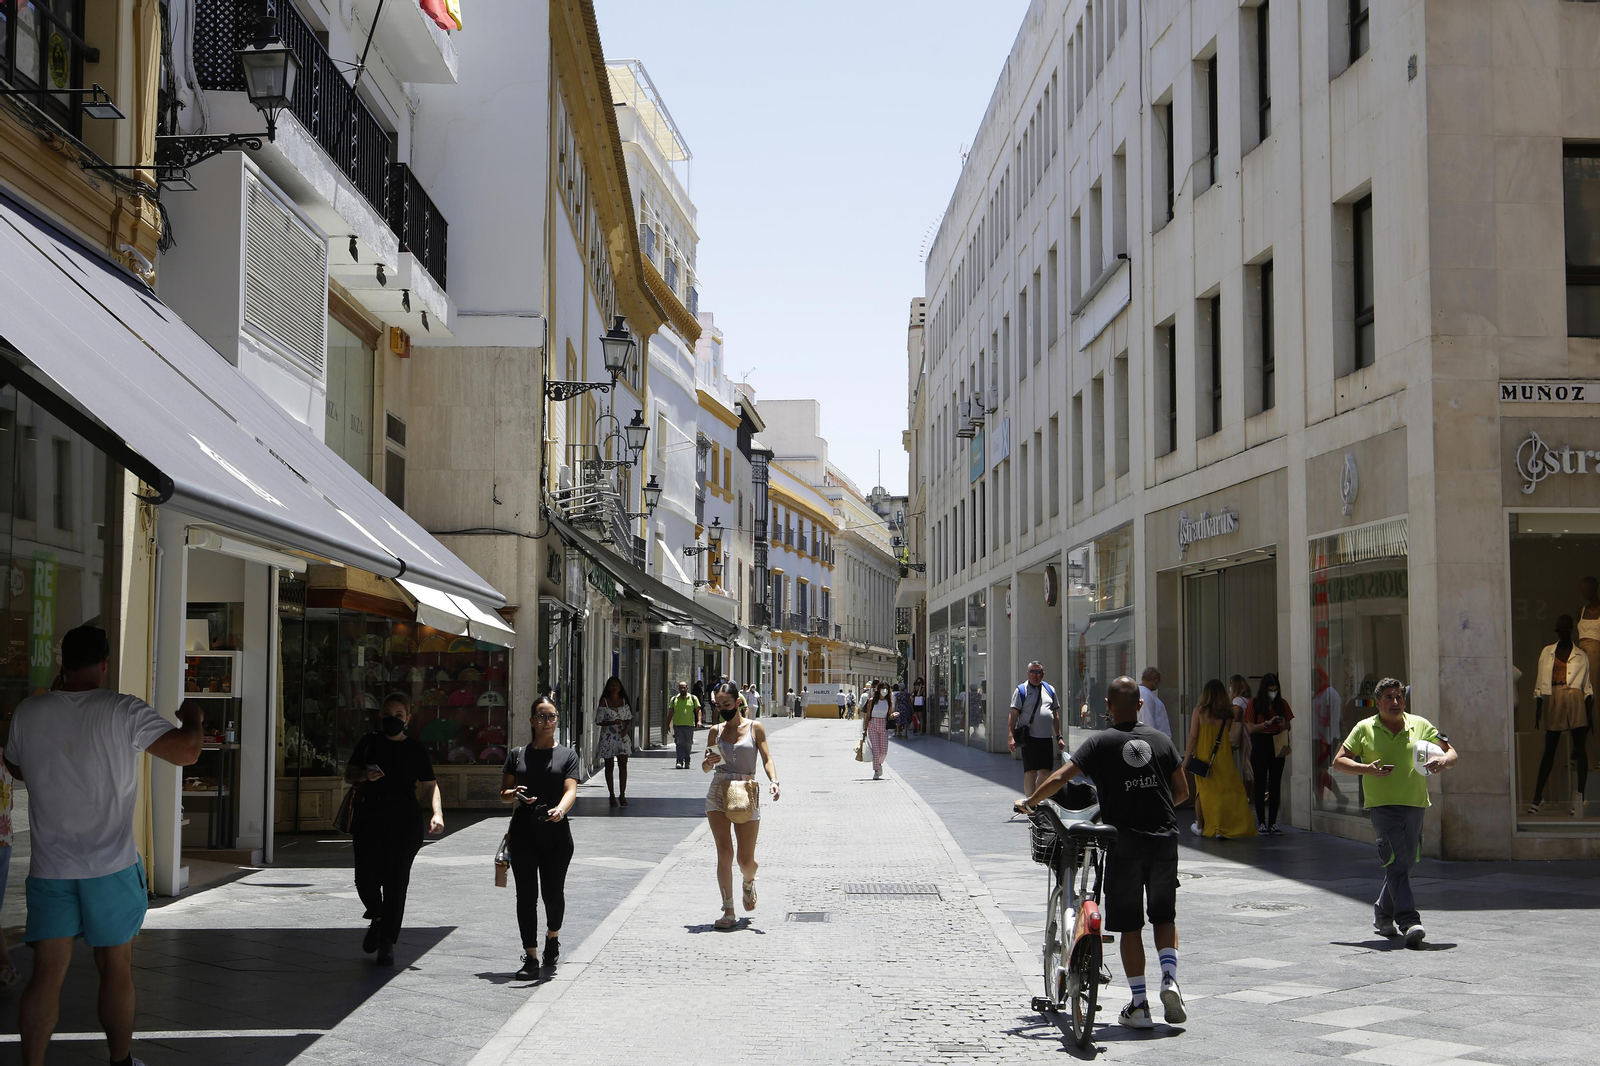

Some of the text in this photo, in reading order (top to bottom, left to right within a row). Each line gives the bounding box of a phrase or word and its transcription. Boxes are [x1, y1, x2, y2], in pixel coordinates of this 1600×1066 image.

[1501, 385, 1585, 401] MUÑOZ
[1544, 445, 1600, 474] str
[35, 560, 53, 597] RE
[33, 599, 52, 636] BA
[31, 639, 51, 667] JAS
[1125, 774, 1158, 791] point
